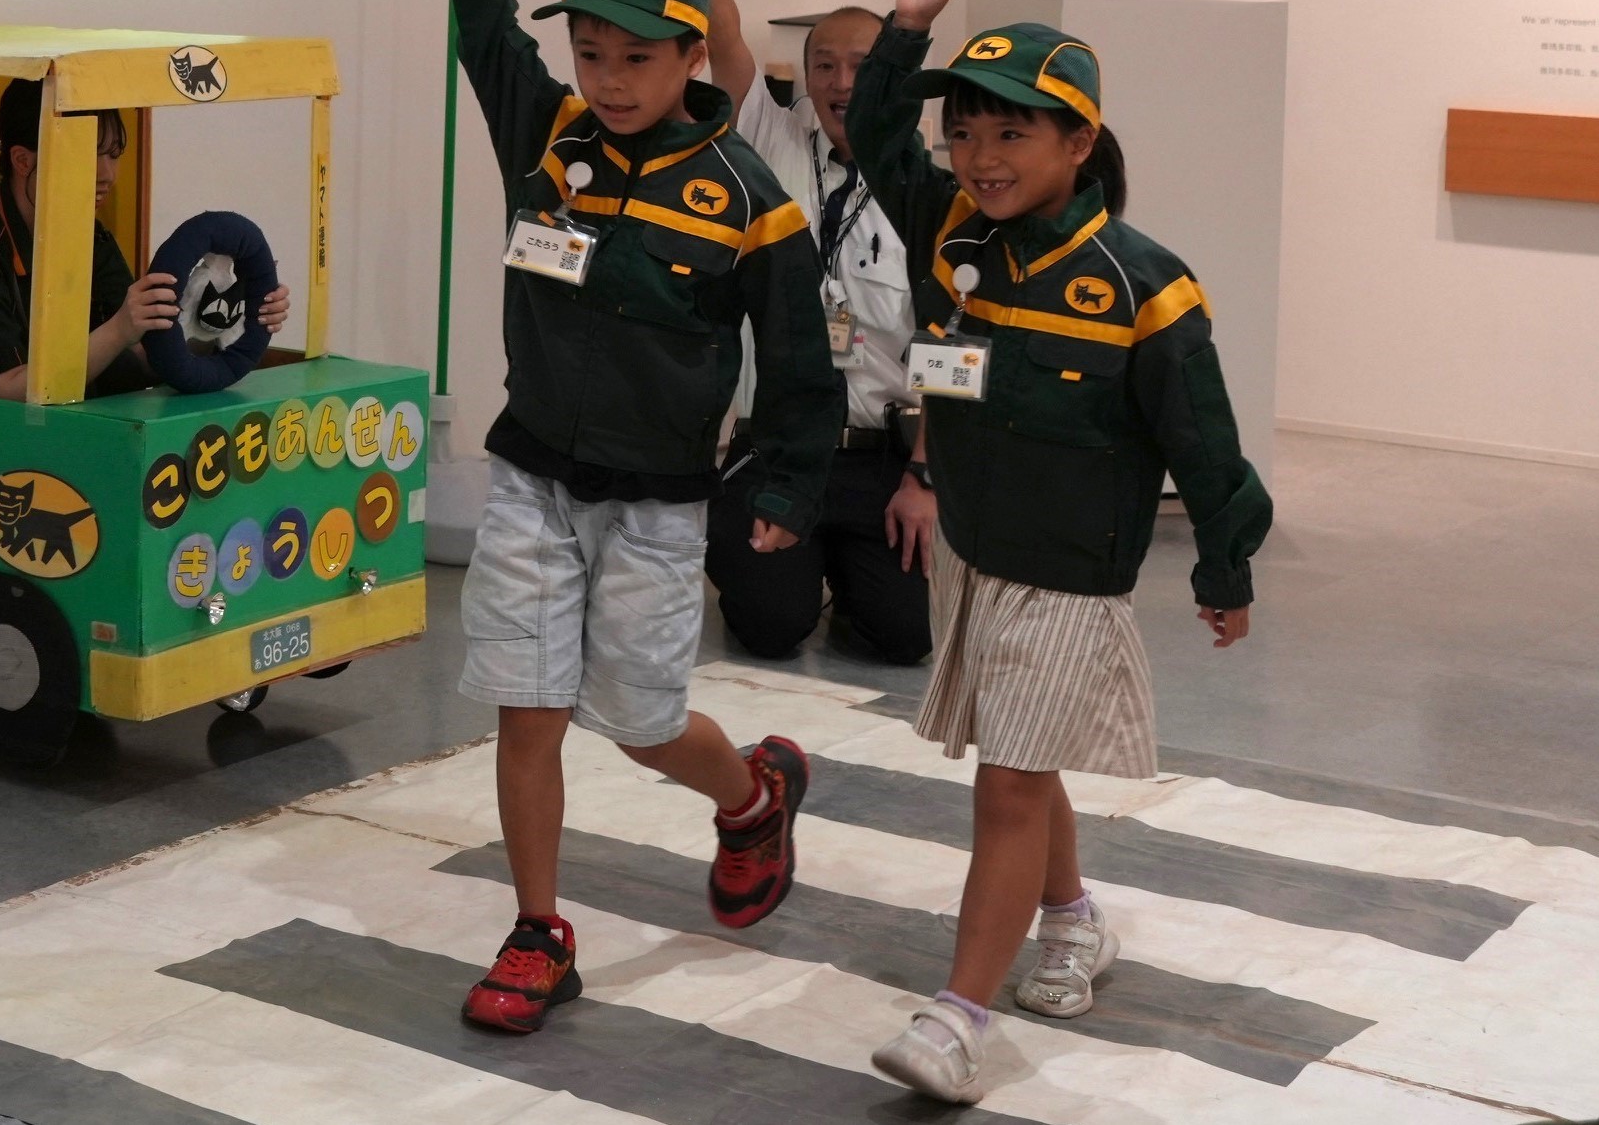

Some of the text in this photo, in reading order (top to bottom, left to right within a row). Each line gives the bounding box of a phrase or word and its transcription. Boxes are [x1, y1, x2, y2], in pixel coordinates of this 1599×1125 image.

[526, 237, 559, 252] こたろう
[174, 486, 394, 598] きょうしつ
[263, 632, 309, 667] 96-25
